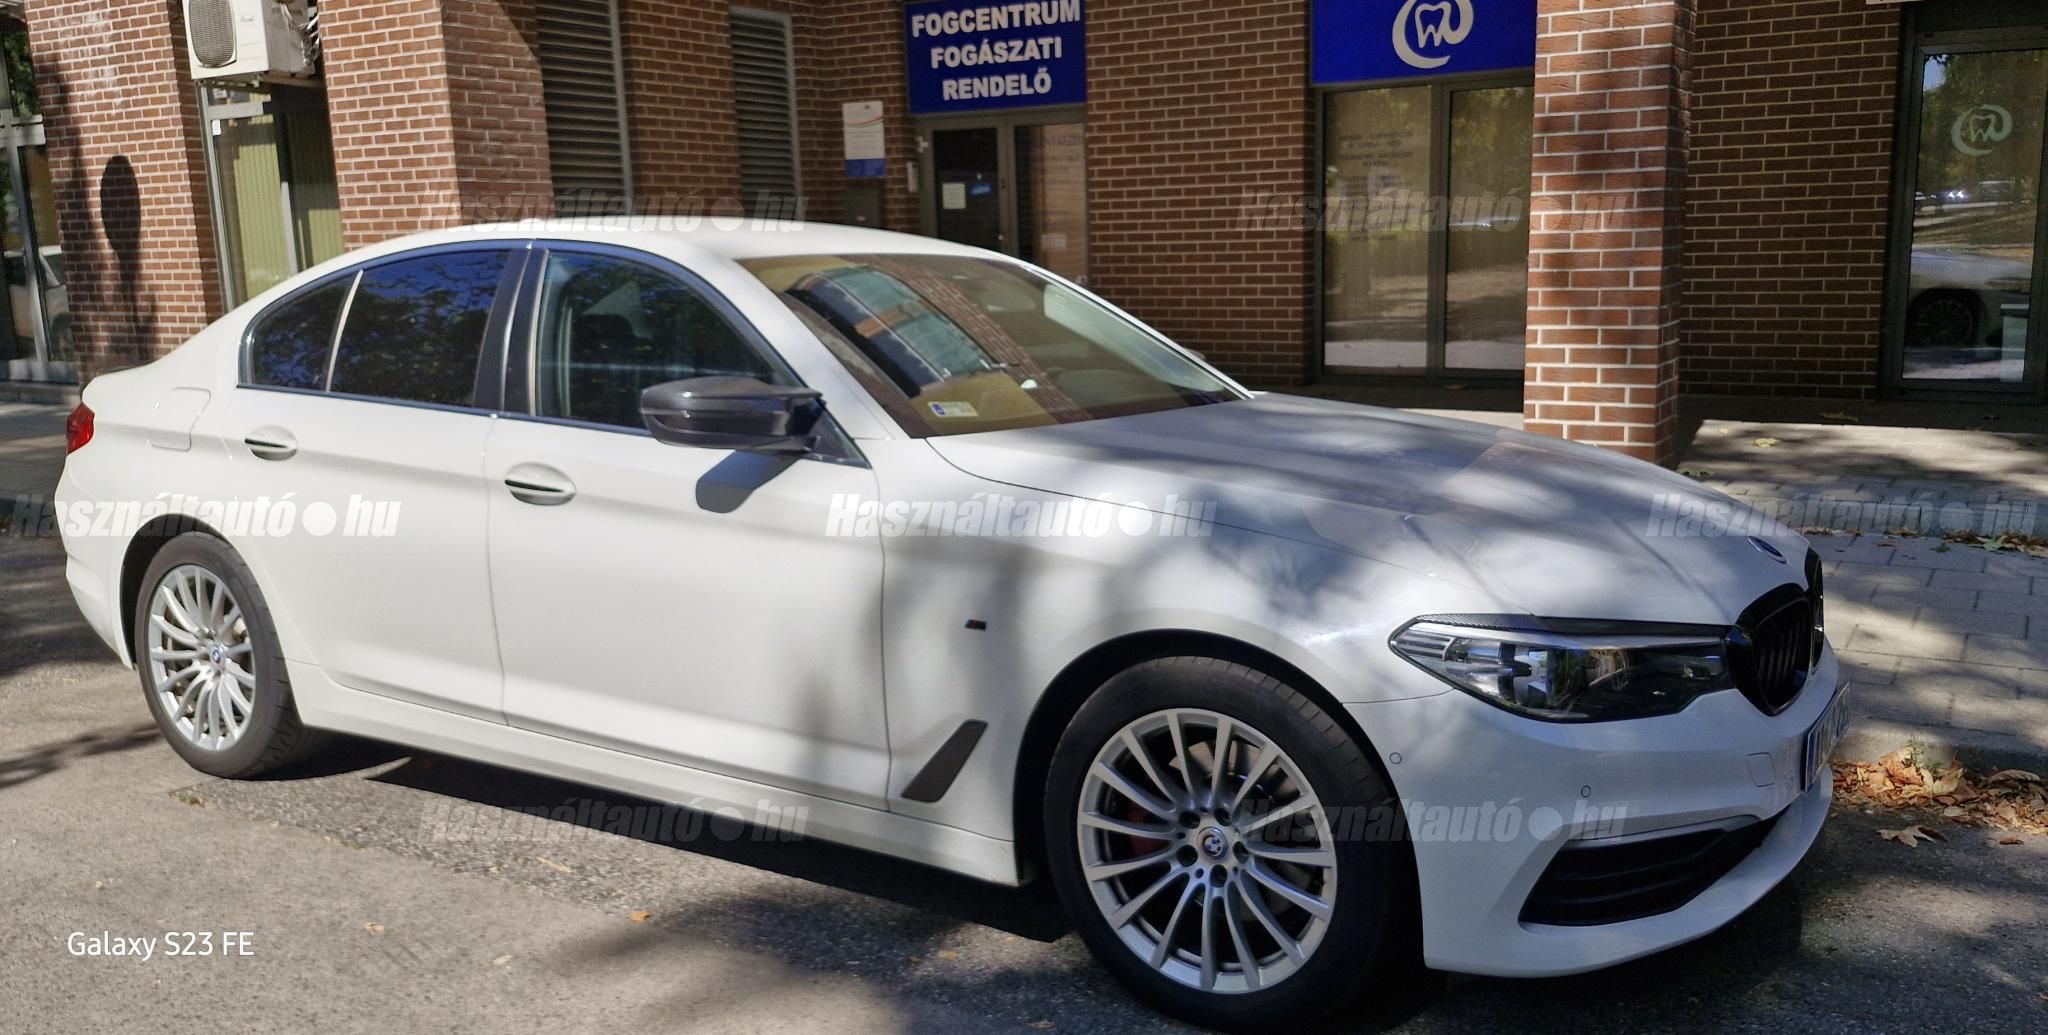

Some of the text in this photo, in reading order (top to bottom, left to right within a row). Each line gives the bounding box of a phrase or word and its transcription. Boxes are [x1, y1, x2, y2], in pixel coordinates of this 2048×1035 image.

[911, 0, 1081, 37] FOGCENTRUM
[930, 36, 1062, 69] FOGÁSZATI
[942, 67, 1052, 101] RENDELŐ
